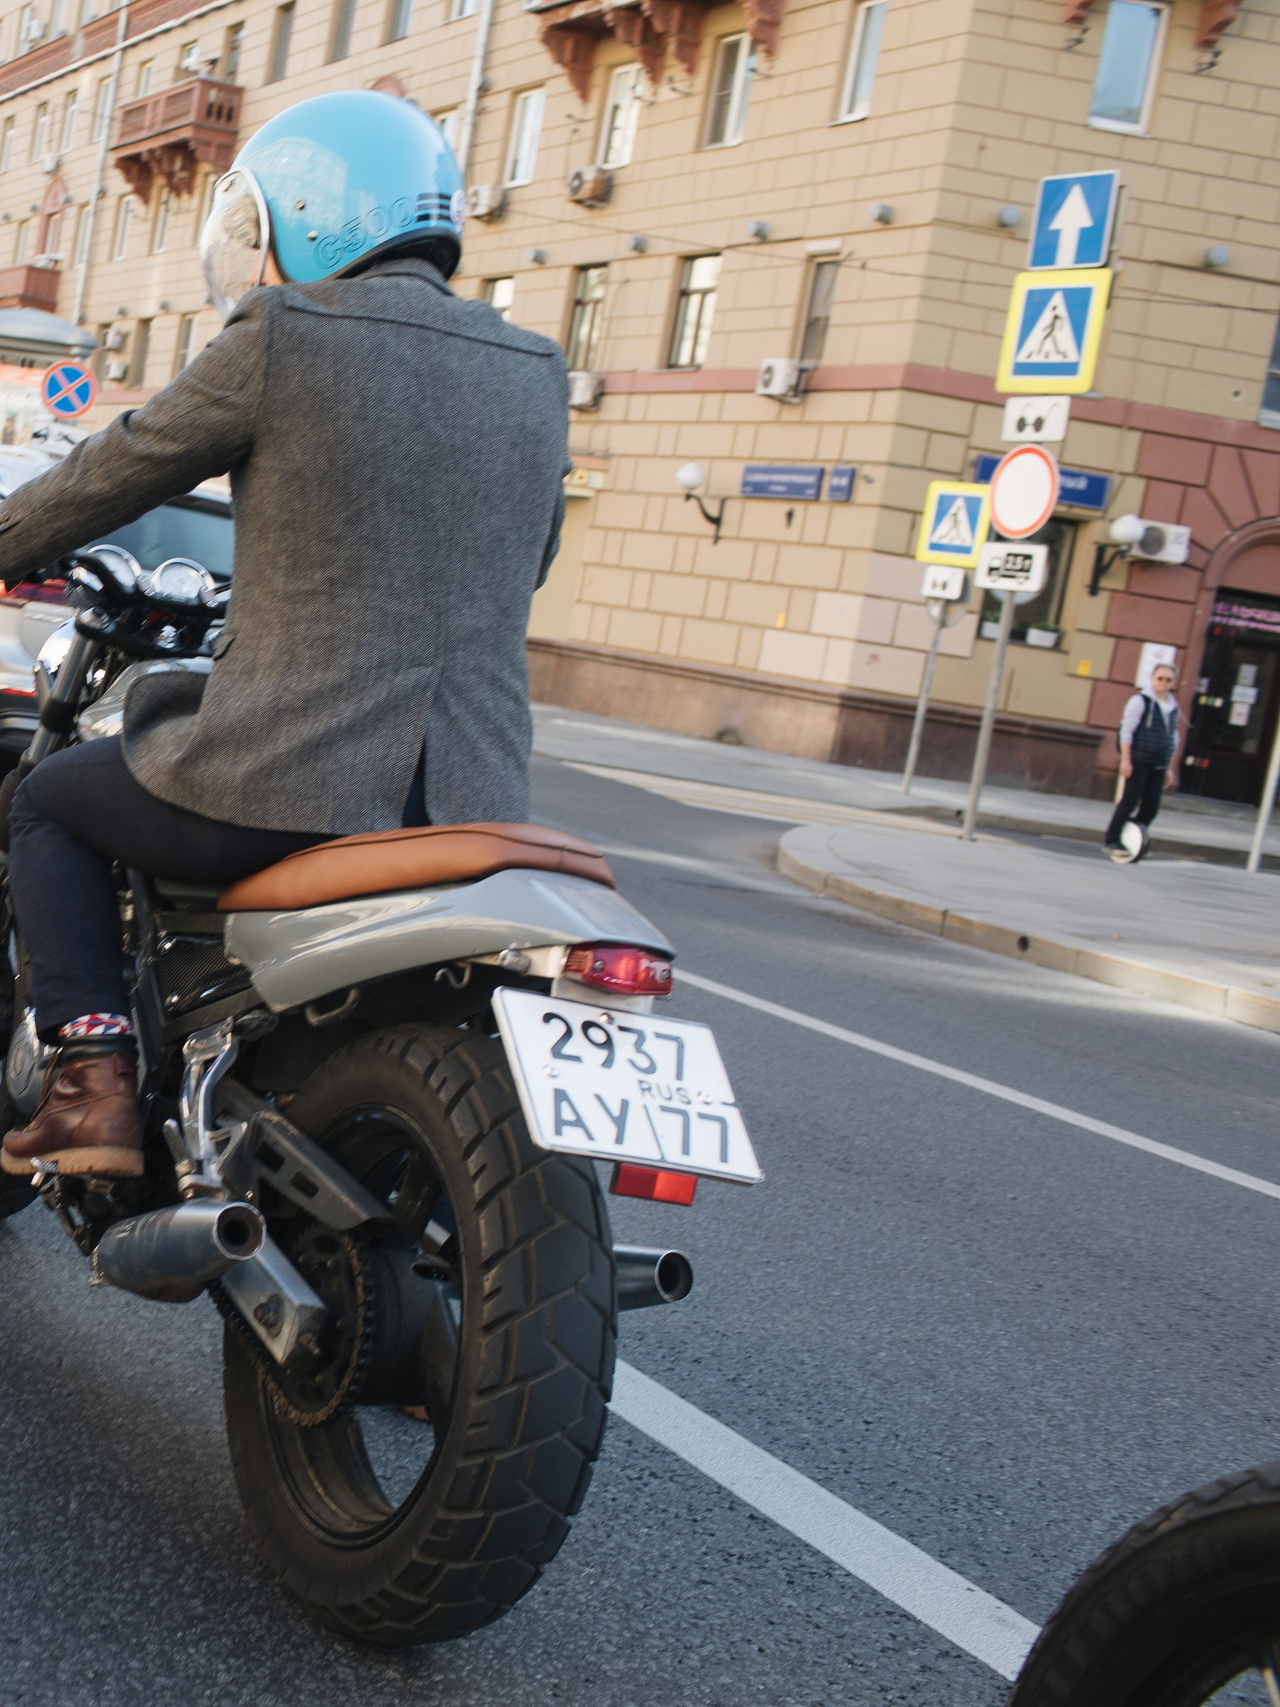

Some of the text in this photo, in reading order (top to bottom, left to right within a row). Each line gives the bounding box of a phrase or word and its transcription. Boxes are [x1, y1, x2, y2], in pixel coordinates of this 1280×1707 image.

[542, 1012, 684, 1080] 2937
[638, 1079, 692, 1105] RUS
[660, 1105, 728, 1163] 77
